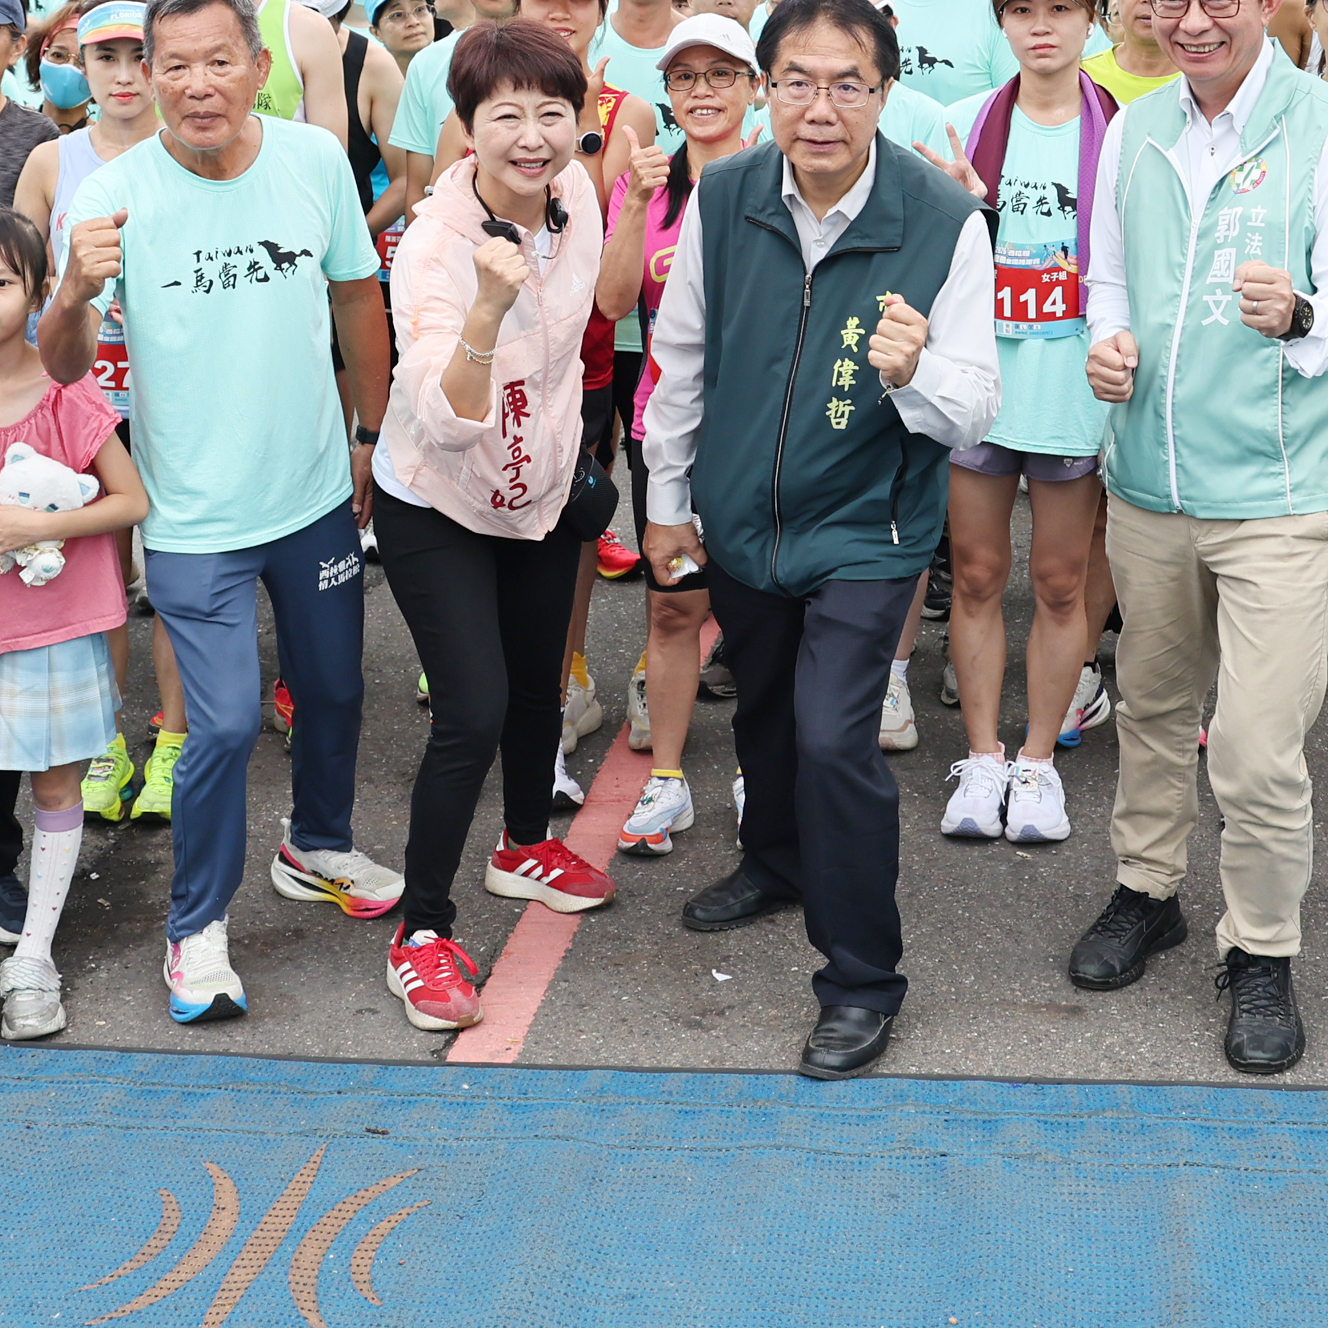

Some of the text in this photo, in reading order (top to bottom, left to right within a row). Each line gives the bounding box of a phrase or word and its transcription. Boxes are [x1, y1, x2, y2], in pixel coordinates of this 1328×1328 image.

[160, 258, 270, 295] 一馬當先
[192, 243, 254, 264] Taiwan
[1041, 270, 1068, 283] 女子組
[1201, 206, 1243, 327] 郭國文
[825, 316, 866, 430] 黃偉哲
[490, 379, 533, 512] 陳亭妃
